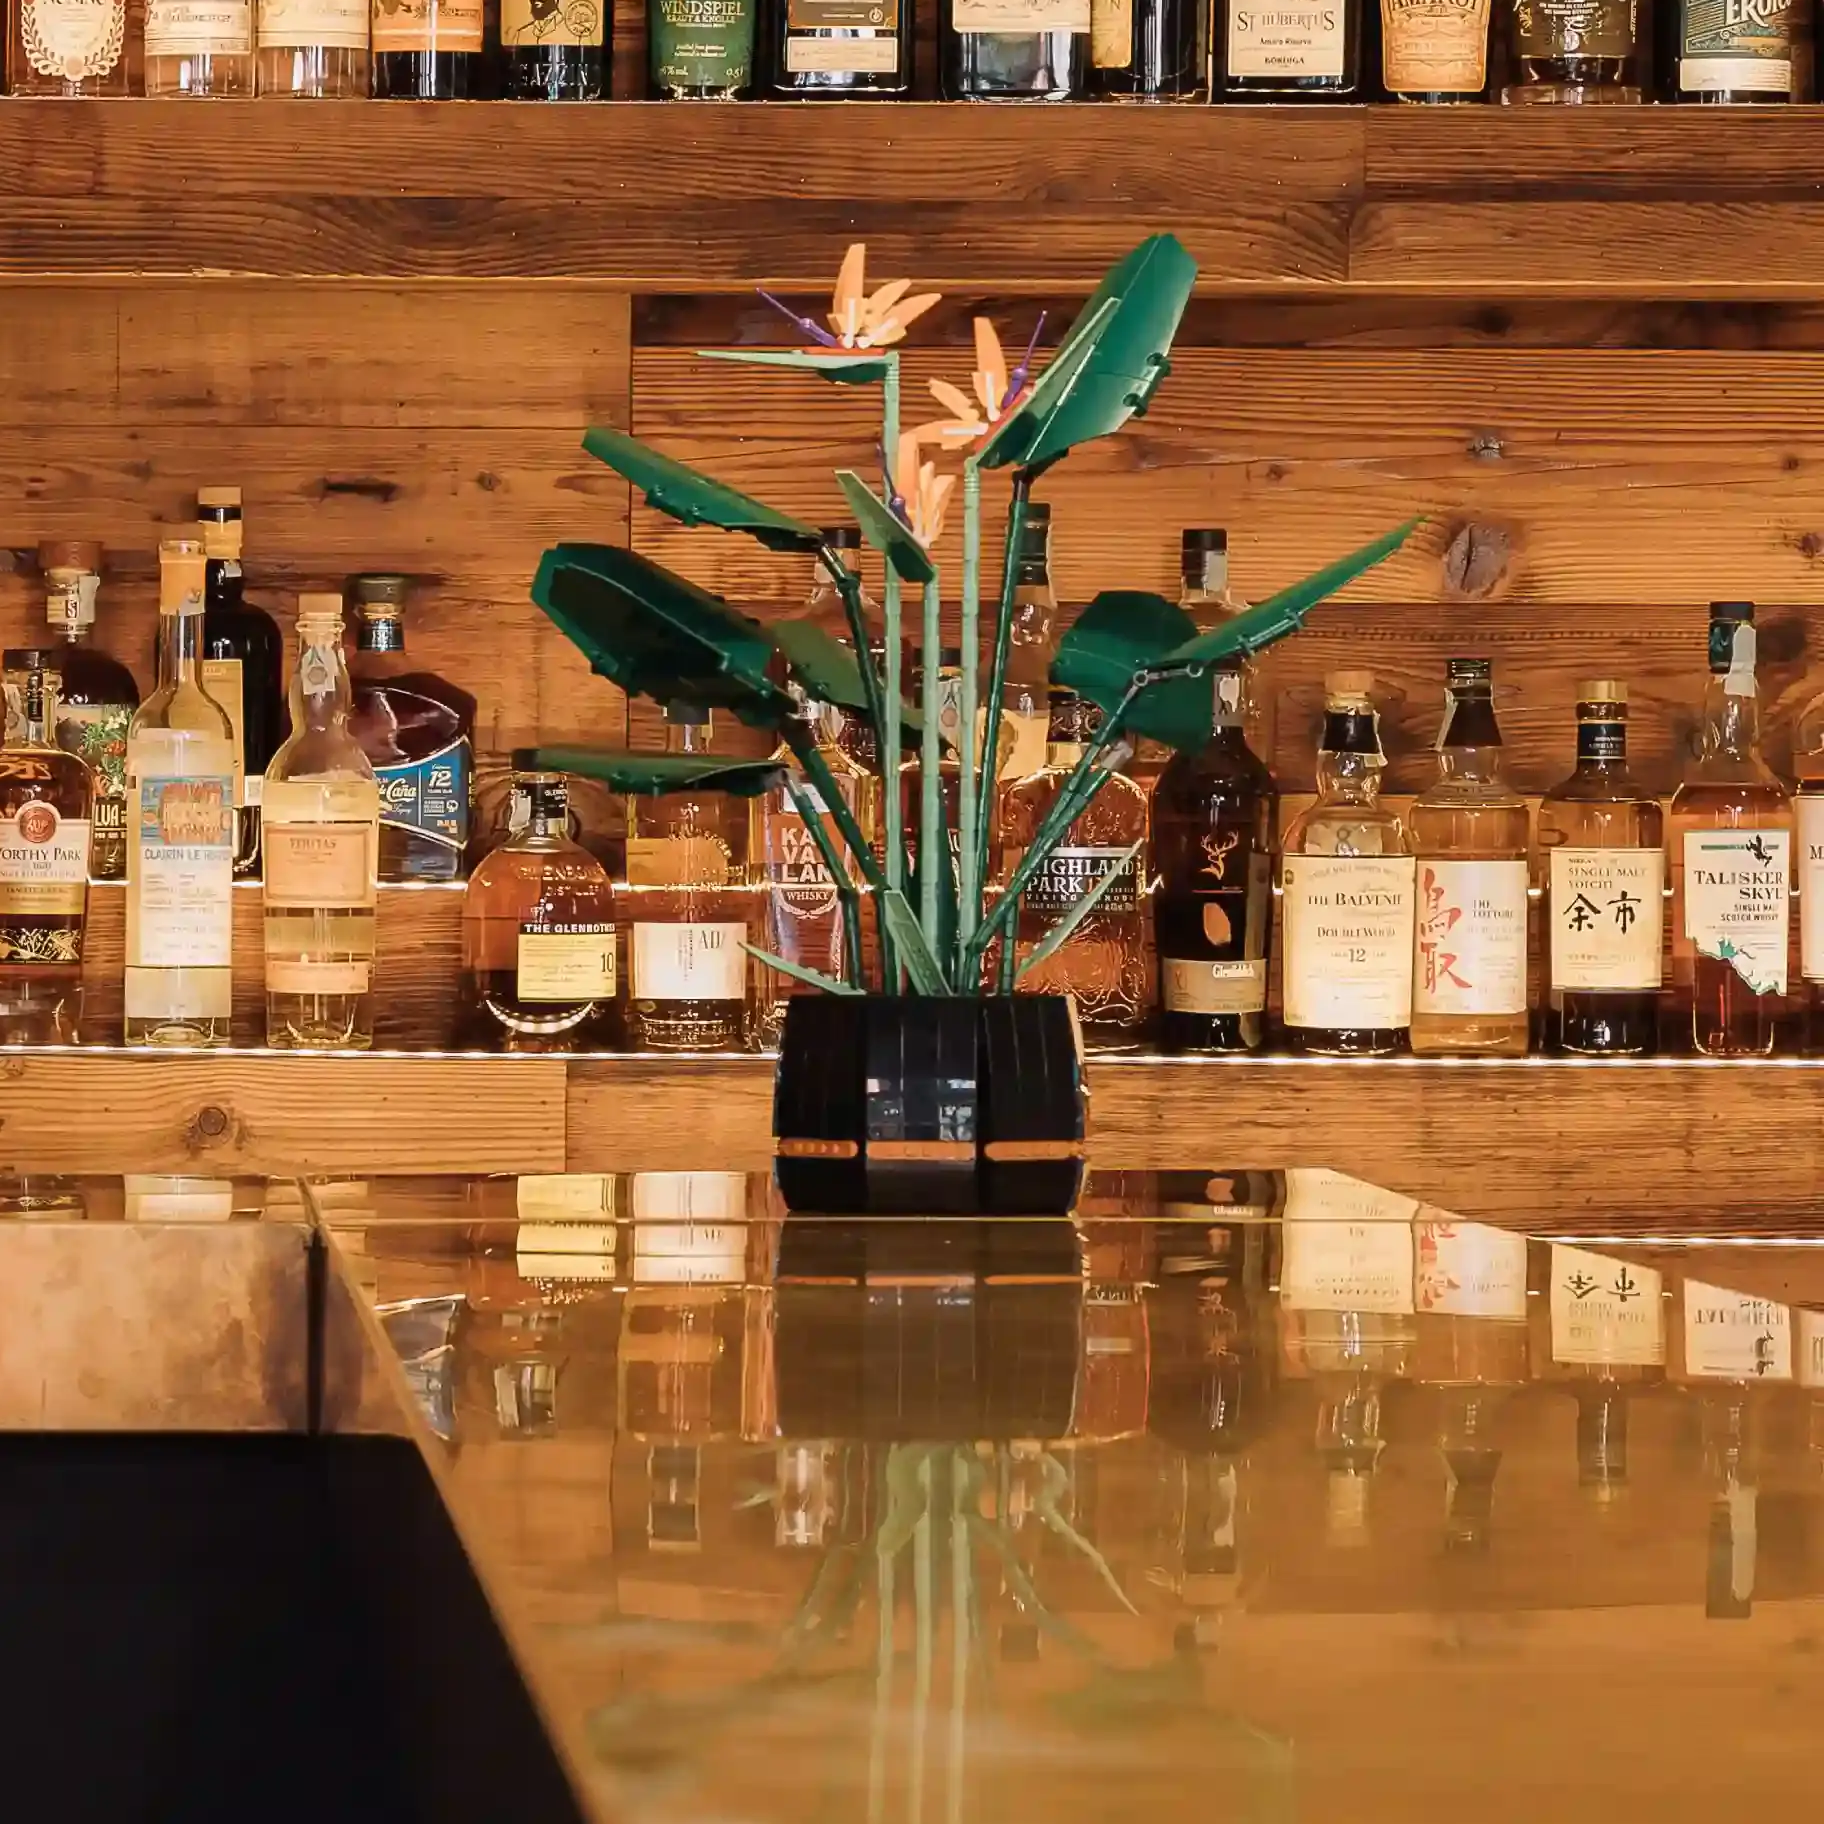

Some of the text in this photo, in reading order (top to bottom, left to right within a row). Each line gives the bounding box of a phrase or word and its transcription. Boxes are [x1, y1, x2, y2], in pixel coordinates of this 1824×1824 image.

[660, 0, 745, 16] WINDSPIEL
[427, 769, 453, 788] 12
[385, 777, 418, 802] Caña
[53, 846, 82, 862] PARK
[781, 845, 818, 865] VA
[1568, 866, 1648, 878] SINGLE MALT
[1693, 869, 1784, 886] TALISKER
[1026, 875, 1084, 895] PARK
[786, 890, 831, 901] WHISKY
[1026, 894, 1078, 903] VIKING
[1307, 892, 1404, 907] THE BALVENIE
[1563, 889, 1642, 935] 余市
[1733, 903, 1762, 912] SINGLE
[1720, 912, 1751, 922] SCOTCH
[523, 922, 616, 934] THE GLENROTHES
[1420, 867, 1474, 995] 鳥取
[599, 951, 614, 973] 10
[1347, 947, 1367, 964] 12
